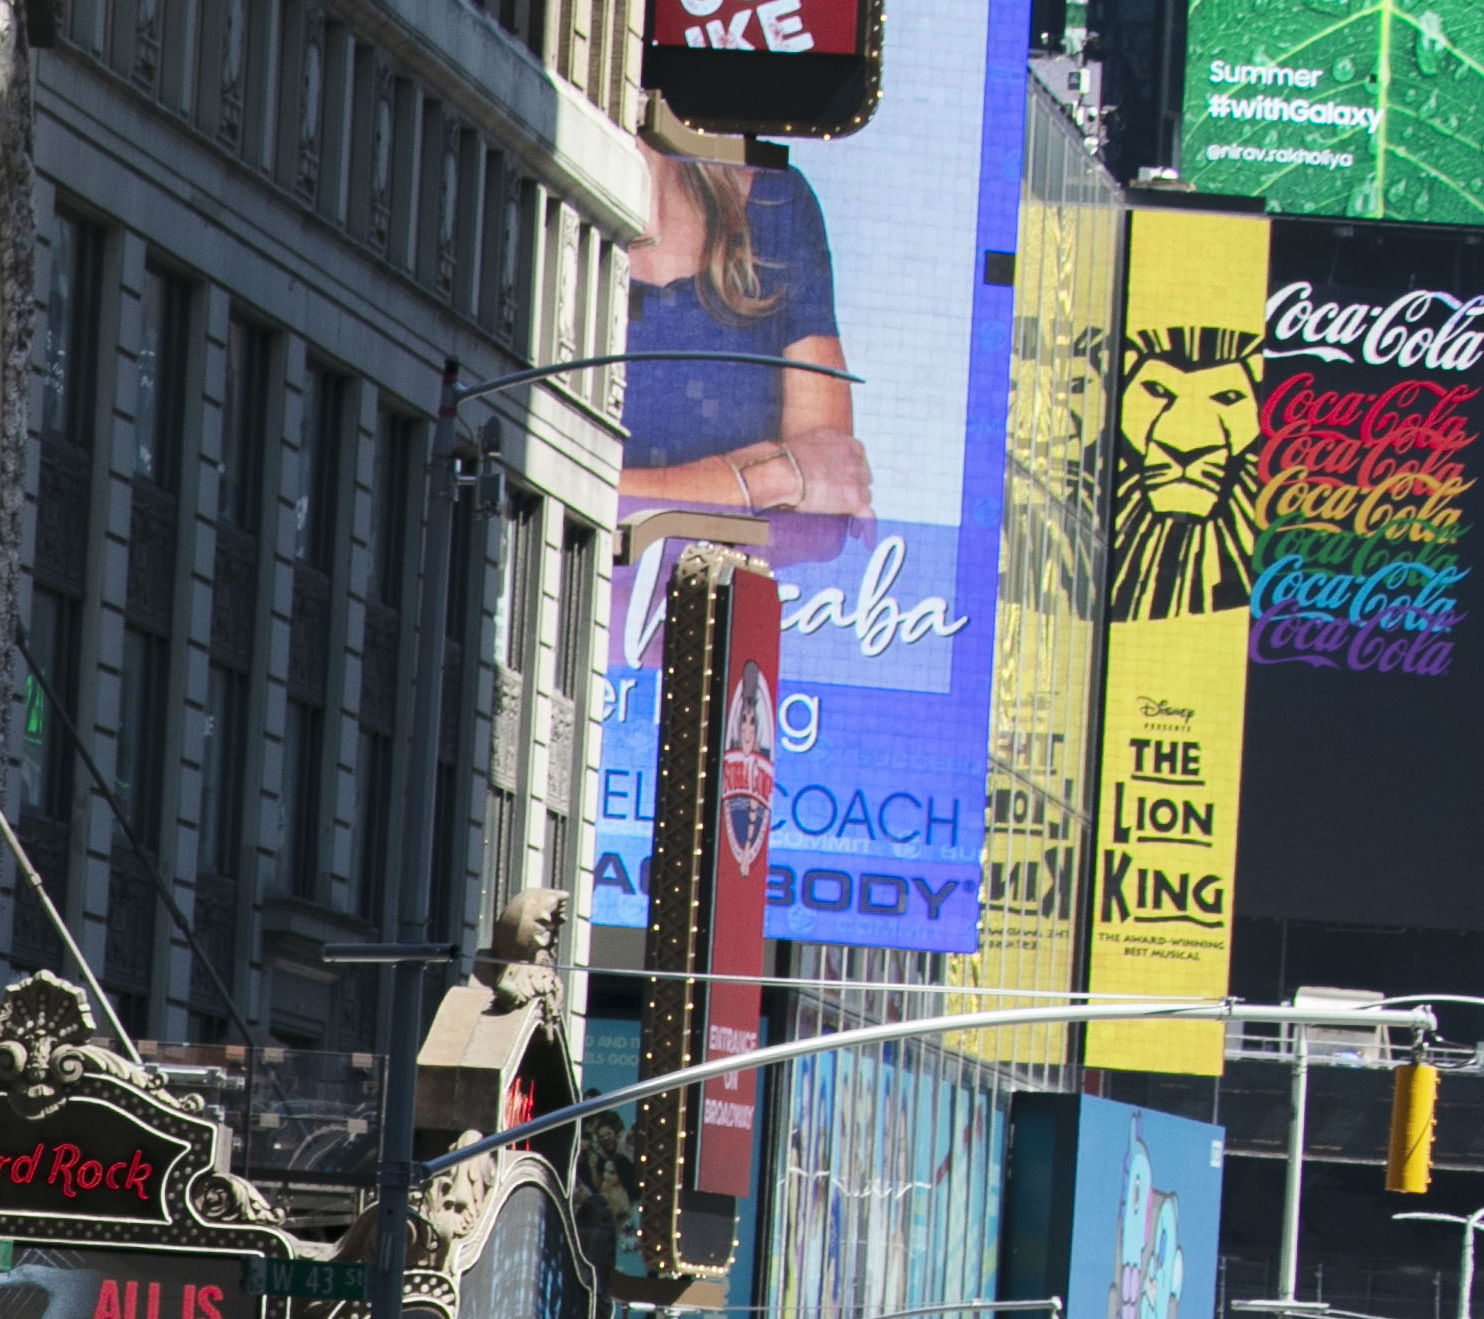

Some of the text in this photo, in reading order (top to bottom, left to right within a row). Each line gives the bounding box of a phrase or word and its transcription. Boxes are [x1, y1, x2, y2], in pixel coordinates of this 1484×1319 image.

[1208, 60, 1323, 88] Summer
[1207, 94, 1384, 133] #withGalaxy
[1264, 281, 1484, 371] Coca-Cola
[1259, 372, 1483, 452] Coca-Cola
[1257, 418, 1479, 497] Coca-Cola
[1255, 465, 1477, 544] Coca-Cola
[1251, 513, 1474, 588] Coca-Cola
[1250, 554, 1472, 632] Coca-Cola
[1248, 599, 1467, 676] Coca-Cola
[1137, 696, 1195, 722] Disney
[1129, 738, 1202, 776] THE
[1113, 782, 1215, 844] LION
[1101, 849, 1225, 923] KING
[709, 1025, 757, 1052] ENTRANCE
[703, 1097, 755, 1132] BROADWAY
[47, 1143, 153, 1200] Rock
[273, 1265, 294, 1290] W
[306, 1269, 334, 1294] 43
